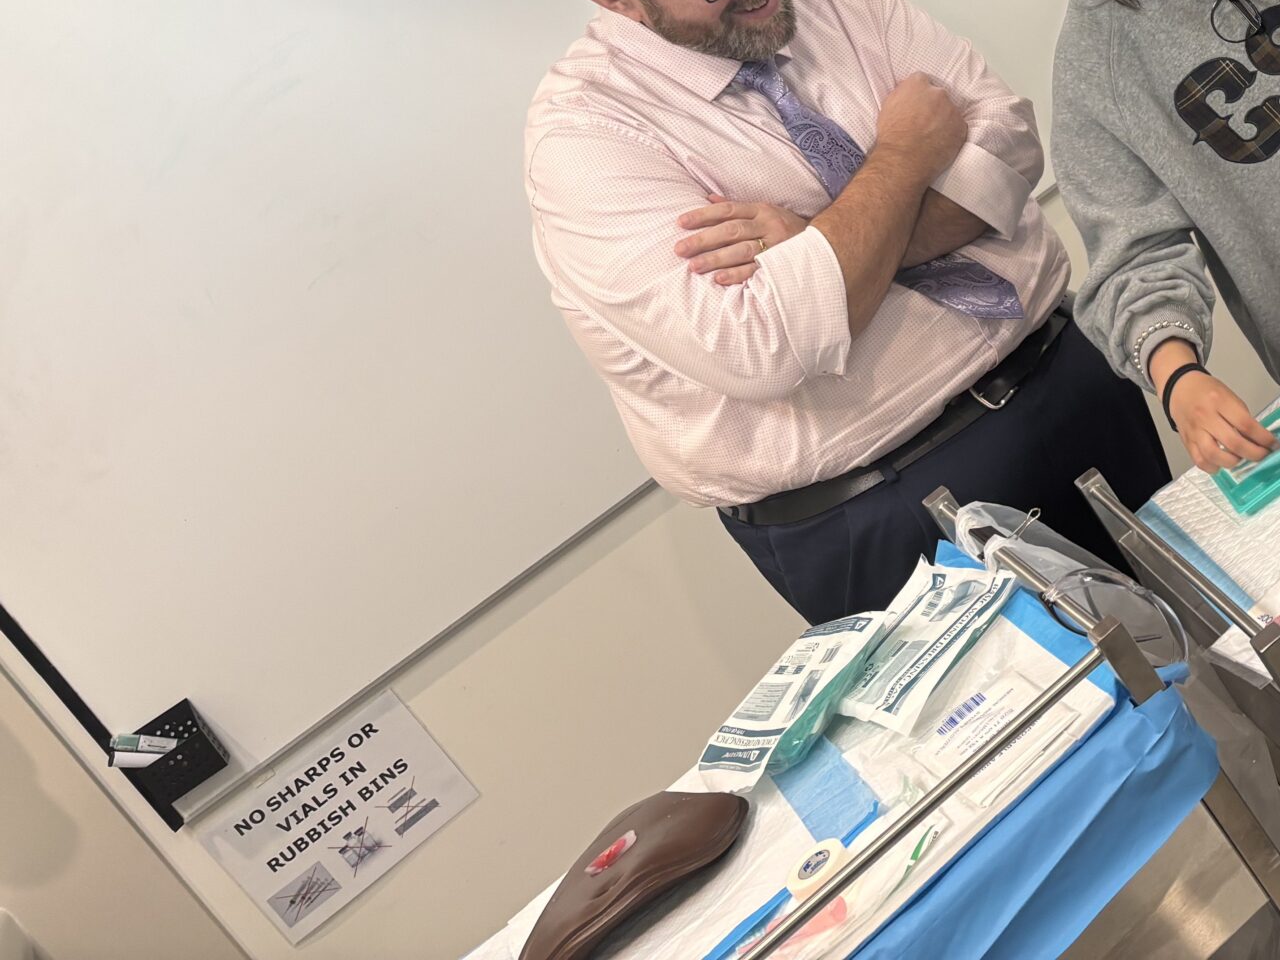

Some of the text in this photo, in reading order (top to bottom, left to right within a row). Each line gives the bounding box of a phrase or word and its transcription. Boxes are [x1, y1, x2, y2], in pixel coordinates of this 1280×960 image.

[942, 605, 977, 641] WOUND
[975, 582, 1000, 607] BASIC
[902, 640, 943, 682] DRESSING
[233, 722, 380, 836] NO SHARPS OR
[276, 760, 368, 833] VIALS IN
[266, 757, 410, 873] RUBBISH BINS
